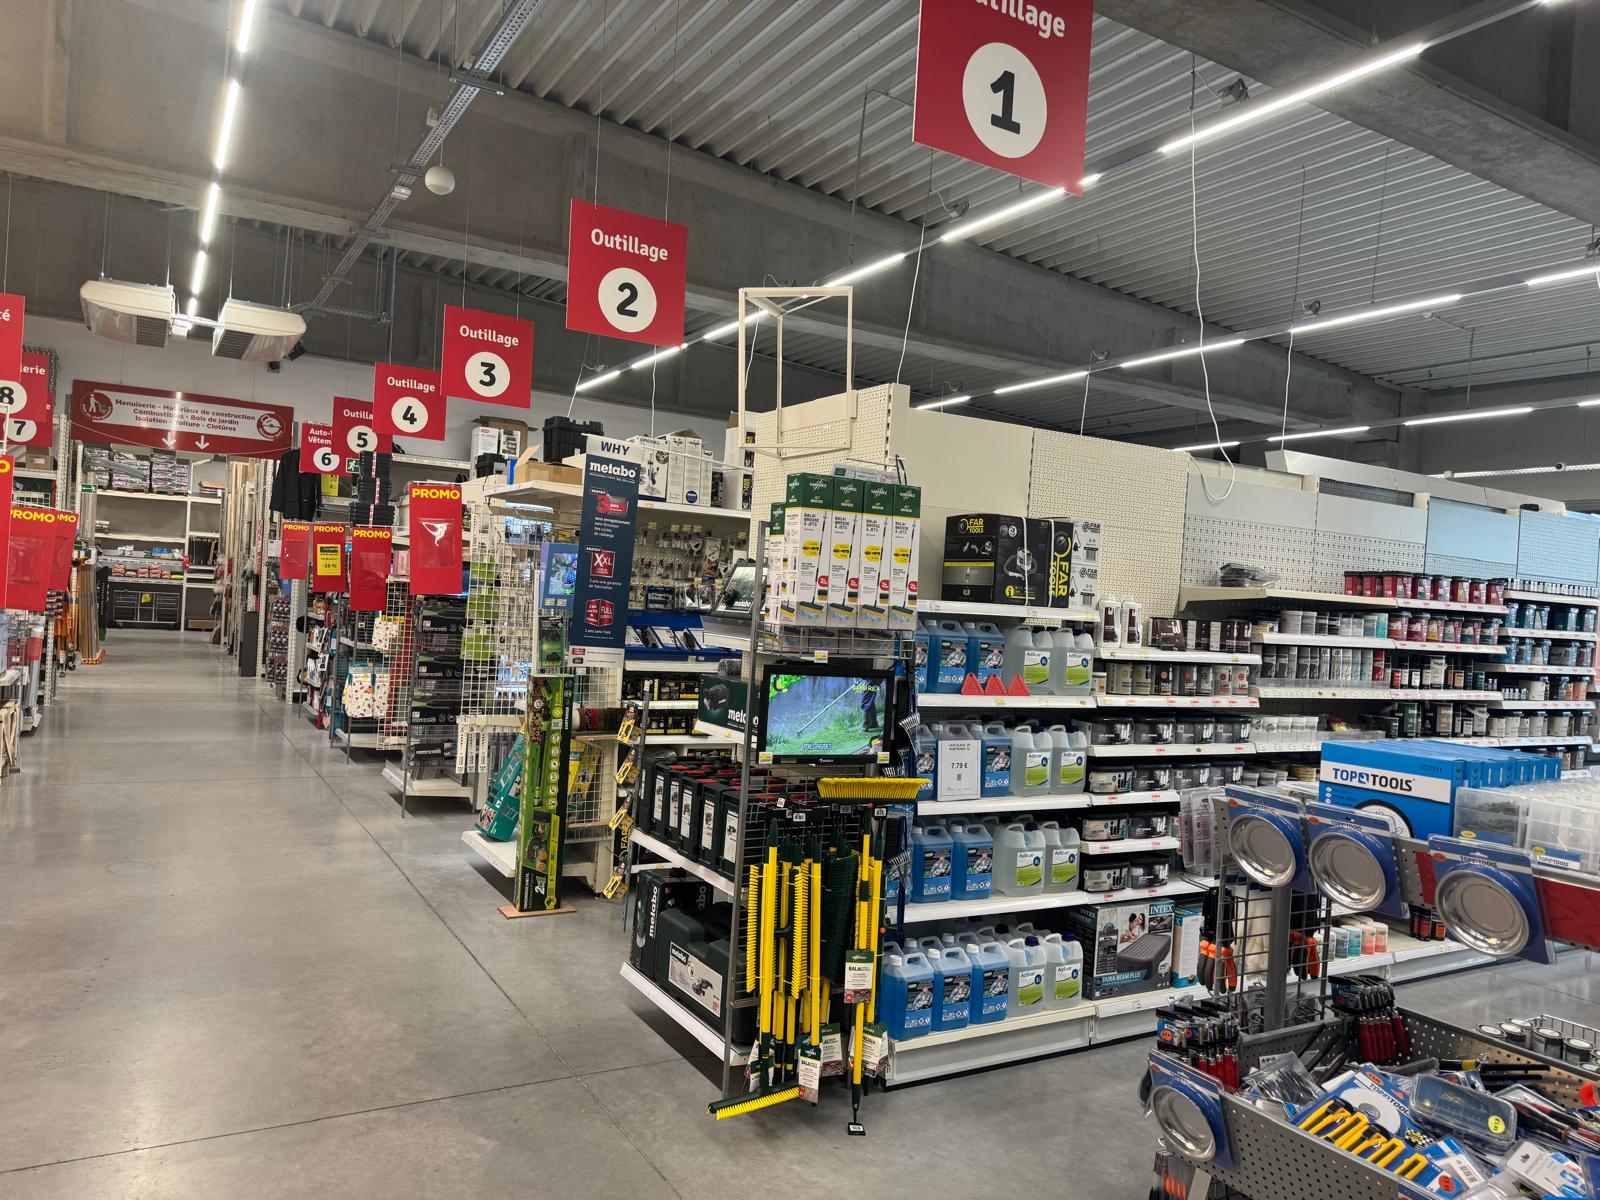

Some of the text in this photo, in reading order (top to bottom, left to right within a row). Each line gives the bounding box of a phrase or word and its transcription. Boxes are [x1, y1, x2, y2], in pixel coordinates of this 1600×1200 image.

[990, 70, 1020, 135] 1
[591, 228, 668, 262] Outillage
[616, 282, 638, 318] 2
[460, 325, 519, 347] Outillage
[479, 362, 496, 387] 3
[387, 376, 436, 393] Outillage
[0, 387, 14, 405] 8
[115, 398, 256, 421] Menuiserie Mariaux de construction
[343, 409, 373, 420] Outilla
[403, 405, 417, 425] 4
[14, 420, 26, 436] 7
[135, 416, 168, 425] Isolation
[191, 414, 204, 422] Bois
[218, 417, 239, 427] jardin
[309, 428, 332, 436] Auto-
[308, 436, 332, 446] Vêtem
[356, 432, 369, 448] 5
[601, 441, 630, 455] WHY
[321, 452, 332, 466] 6
[589, 461, 636, 478] metabo
[412, 488, 460, 499] PROMO
[11, 510, 55, 523] ROMO
[970, 518, 984, 526] FAR
[353, 530, 391, 539] PROMO
[594, 553, 612, 566] XXL
[1058, 561, 1069, 597] FAR
[601, 606, 612, 614] FULL
[1333, 768, 1412, 792] TOP TOOLS
[1150, 904, 1173, 914] INTEX
[1102, 973, 1129, 982] DURA-BEAM
[1389, 1097, 1409, 1115] TOOL
